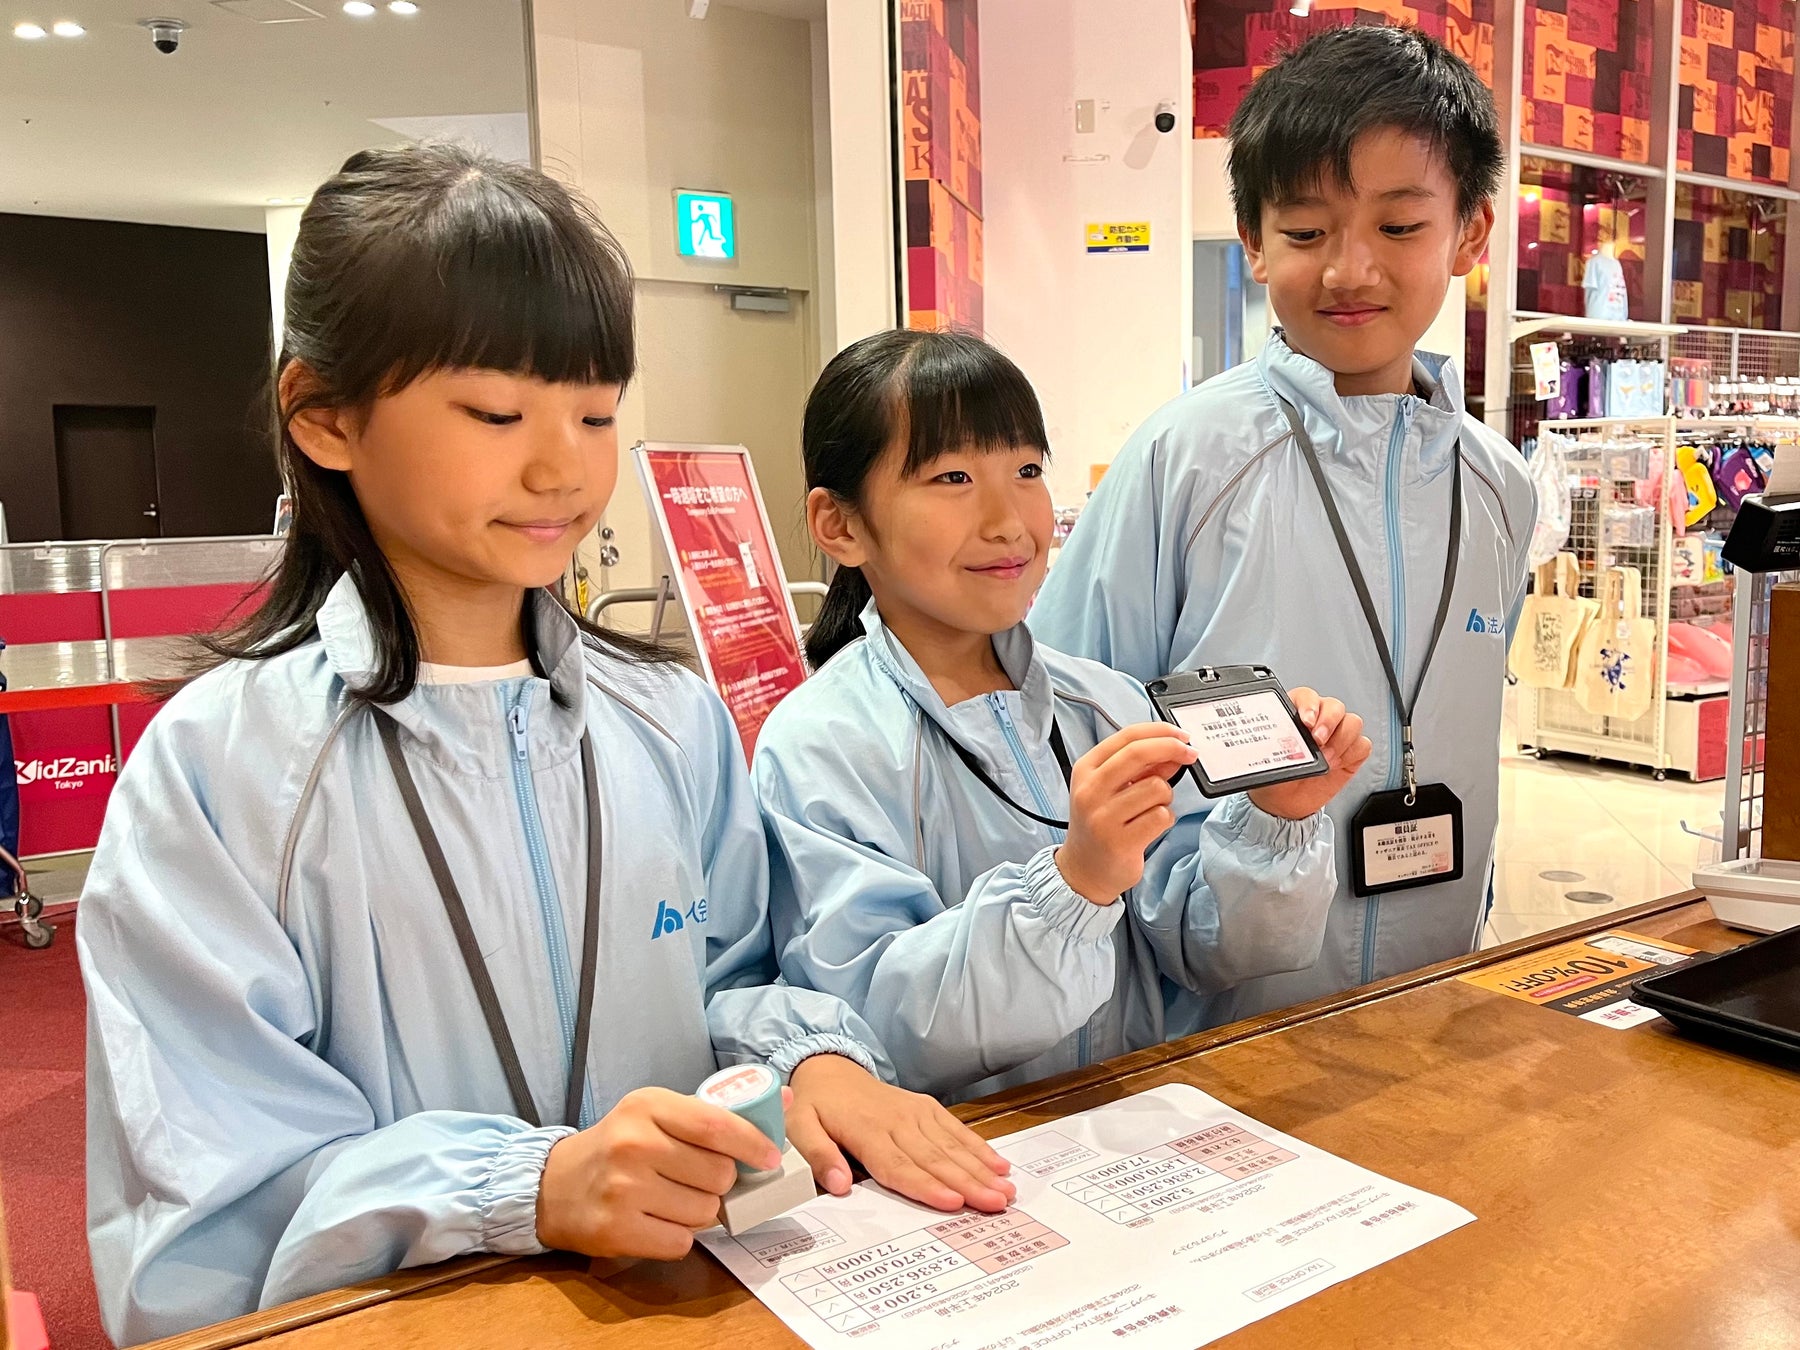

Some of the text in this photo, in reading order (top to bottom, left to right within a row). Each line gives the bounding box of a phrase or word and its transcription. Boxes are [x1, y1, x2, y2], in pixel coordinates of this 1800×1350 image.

[55, 780, 84, 790] Tokyo
[1500, 956, 1629, 993] 10%OFF!
[1235, 1154, 1278, 1172] 販売数量
[959, 1217, 1012, 1239] 仕入れ額
[982, 1230, 1022, 1248] 売上額
[834, 1242, 900, 1270] 77,000
[993, 1240, 1046, 1262] 販売数量
[848, 1244, 942, 1282] 1,870,000
[1304, 1261, 1323, 1273] TAX
[864, 1255, 959, 1295] 2,836,250
[1276, 1269, 1305, 1285] OFFICE
[880, 1282, 938, 1309] 5,200
[932, 1278, 1020, 1318] 2024年上半期
[1111, 1304, 1177, 1337] 消費税申告書
[1030, 1328, 1071, 1348] OFFICE
